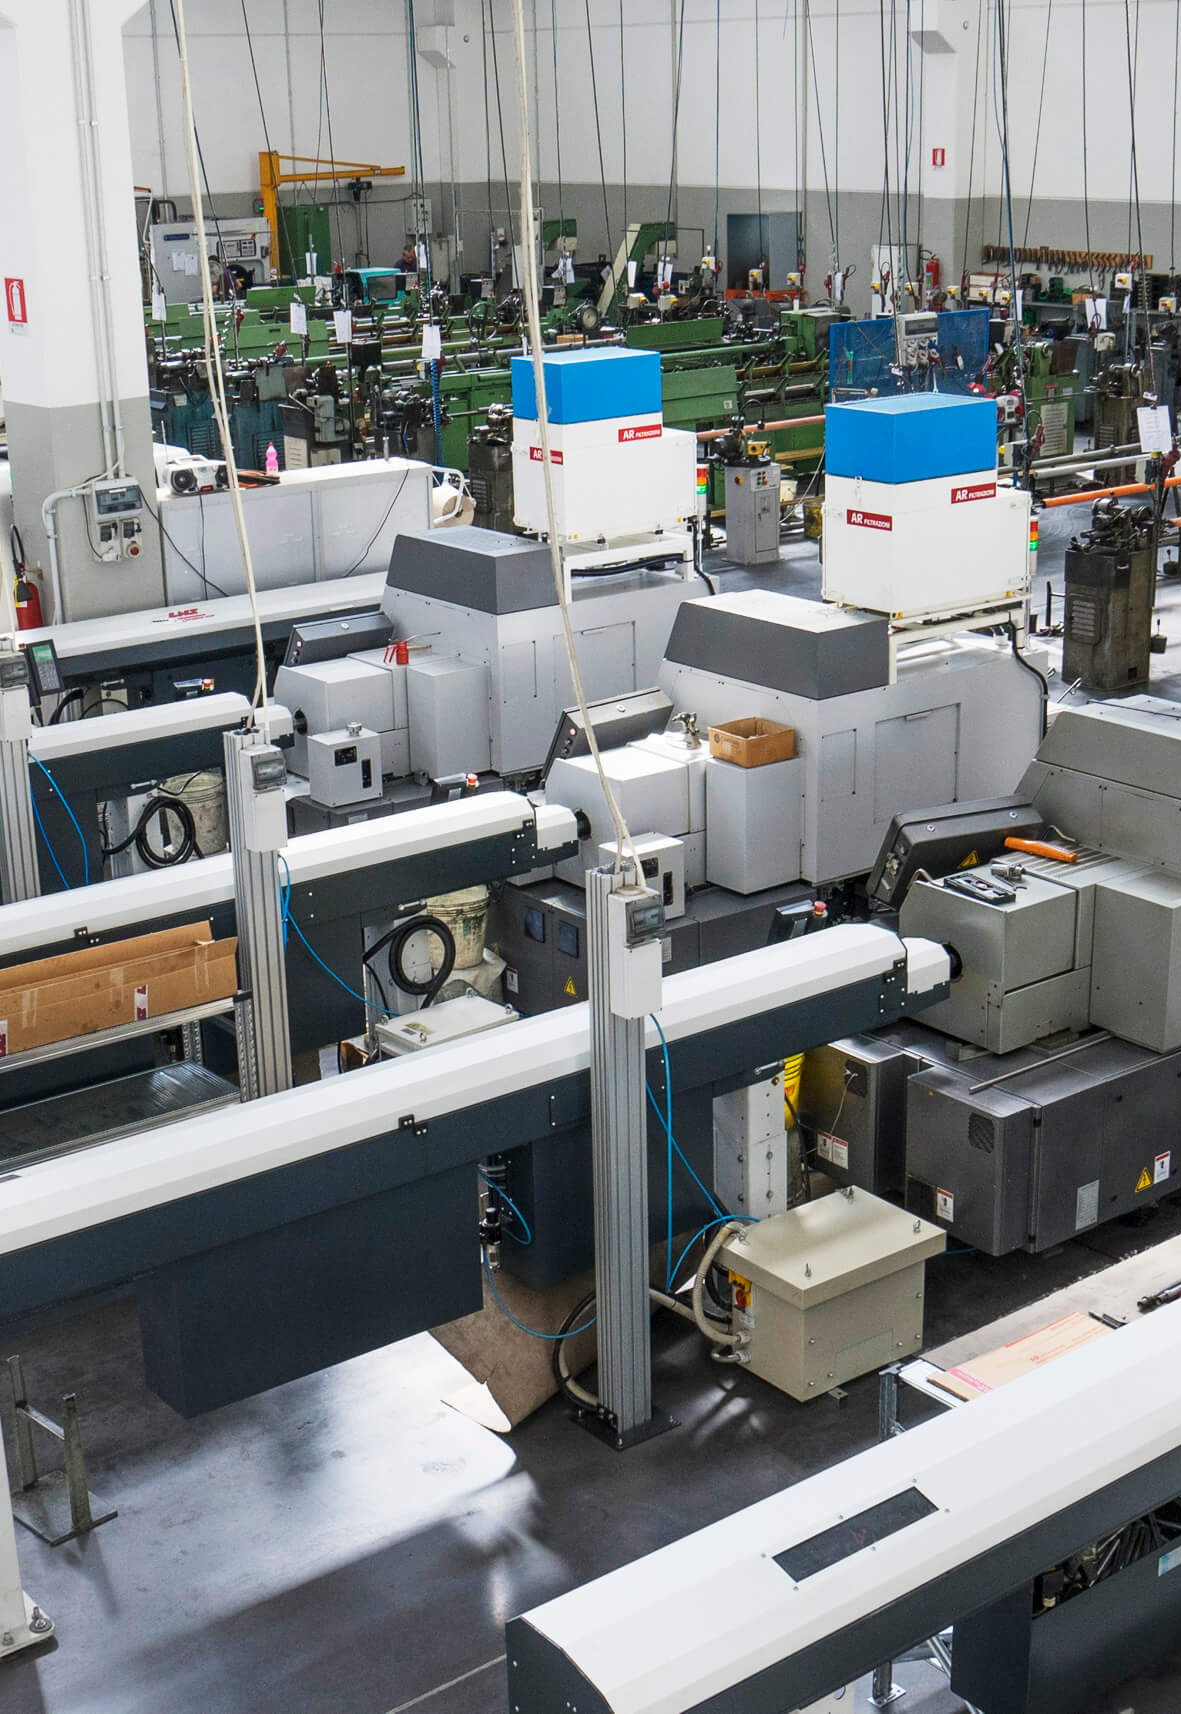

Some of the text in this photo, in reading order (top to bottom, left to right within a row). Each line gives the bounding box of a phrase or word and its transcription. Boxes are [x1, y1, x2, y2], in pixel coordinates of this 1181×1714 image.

[623, 430, 635, 440] AR
[955, 489, 968, 502] AR
[850, 511, 864, 525] AR
